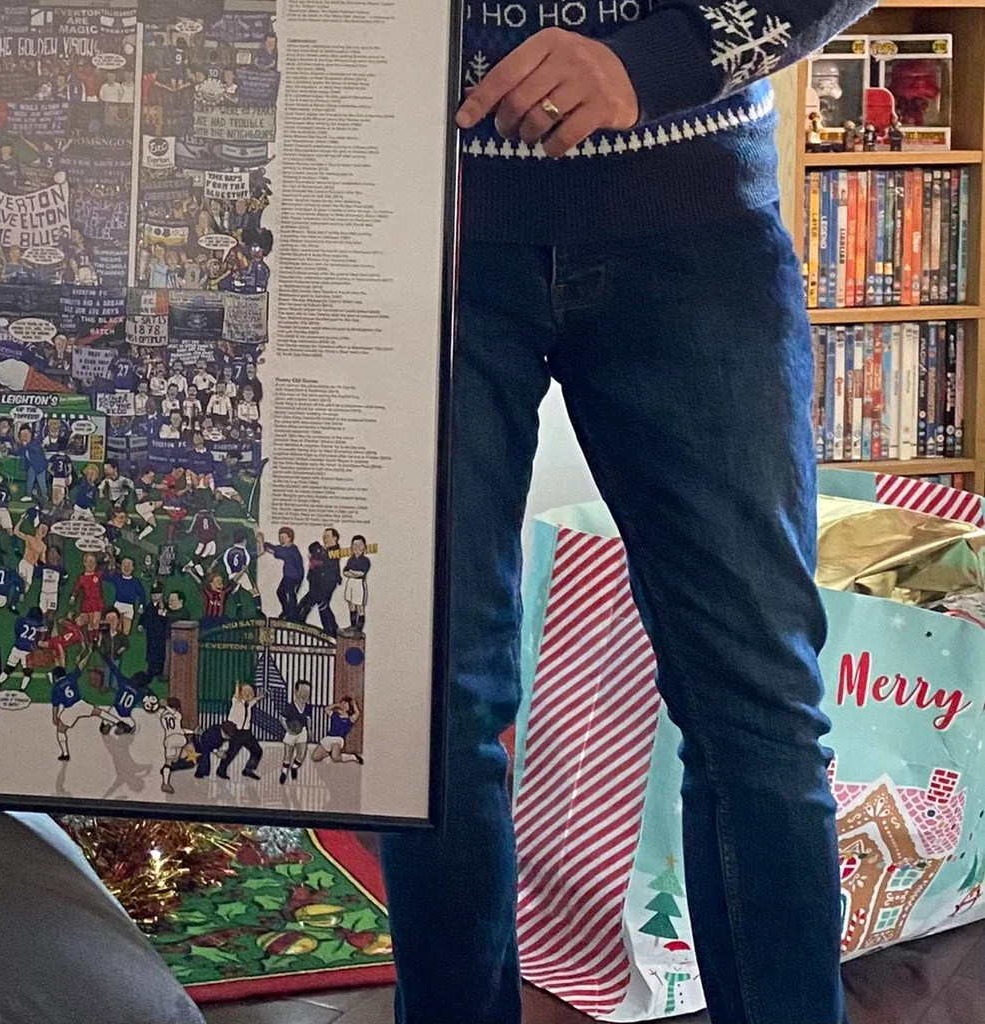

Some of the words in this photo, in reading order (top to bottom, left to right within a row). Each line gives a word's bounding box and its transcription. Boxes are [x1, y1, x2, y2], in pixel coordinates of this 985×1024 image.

[482, 2, 527, 27] HO
[539, 2, 587, 26] HO
[599, 0, 640, 23] HO
[66, 17, 89, 25] ARE
[59, 26, 98, 35] MAGIC
[18, 37, 58, 56] GOLDEN
[175, 54, 182, 64] 9
[19, 224, 70, 249] BLUES
[134, 326, 161, 335] 1878
[117, 364, 129, 376] 27
[1, 394, 59, 406] LEIGHTON'S
[58, 460, 64, 471] 3
[233, 553, 239, 566] 6
[20, 624, 36, 641] 22
[63, 631, 72, 641] 4
[205, 643, 248, 651] EVERTON
[65, 687, 74, 699] 6
[836, 651, 970, 730] Merry
[120, 691, 135, 708] 10
[165, 716, 175, 730] 10
